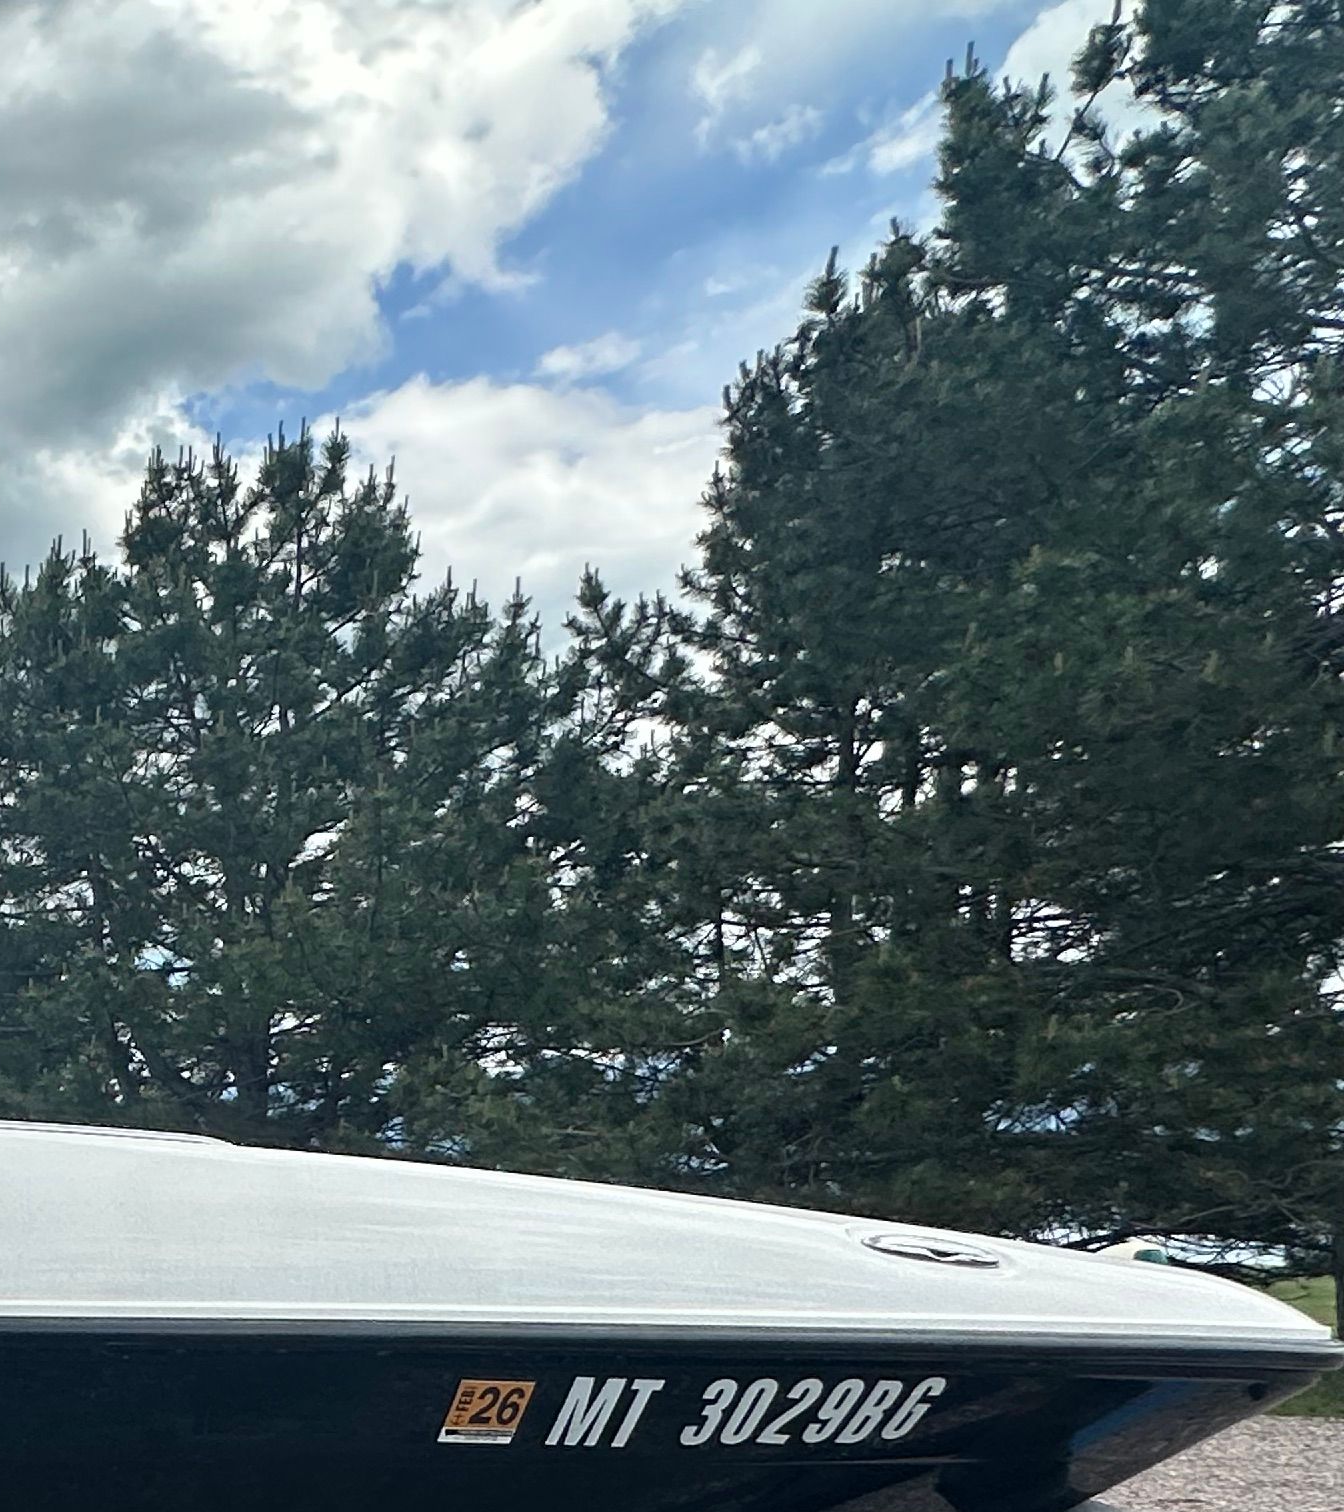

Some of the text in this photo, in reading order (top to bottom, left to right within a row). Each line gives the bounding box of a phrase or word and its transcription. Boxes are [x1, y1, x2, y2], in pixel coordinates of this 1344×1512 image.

[468, 1386, 526, 1426] 26
[544, 1376, 947, 1448] MT 3029BG
